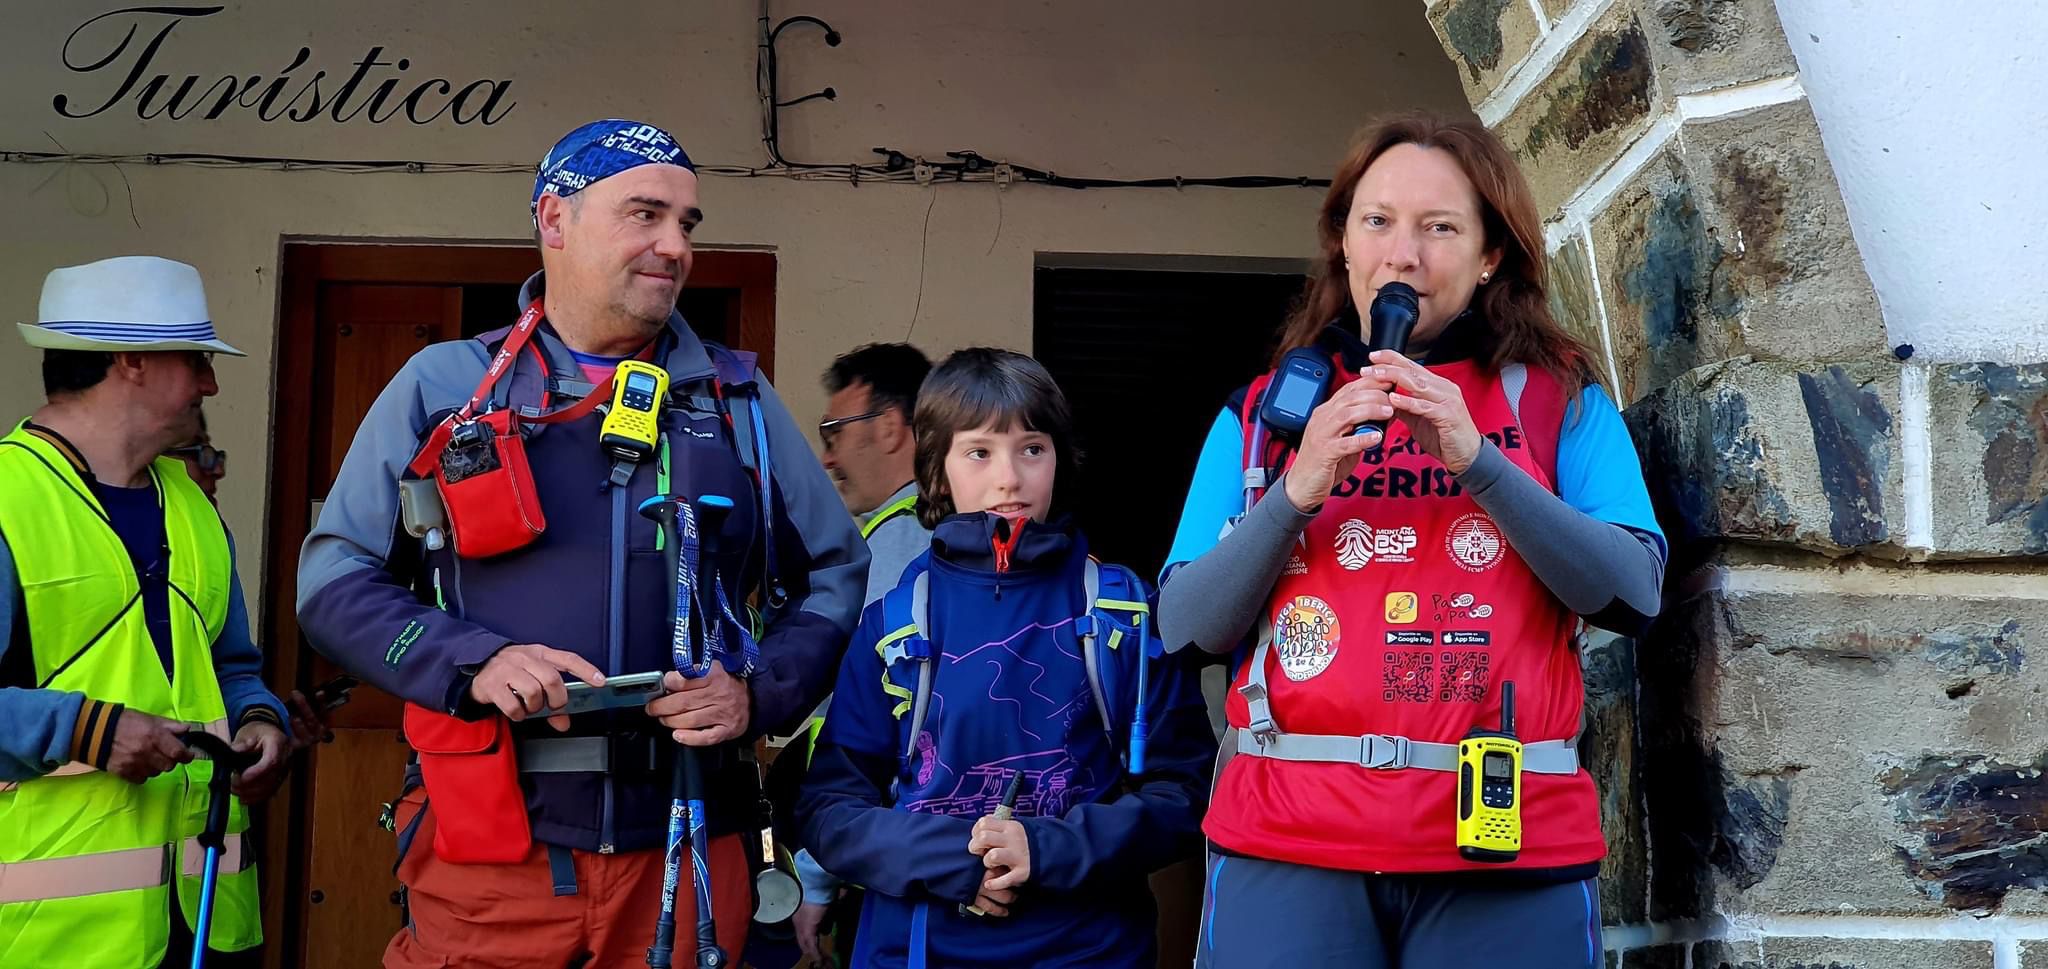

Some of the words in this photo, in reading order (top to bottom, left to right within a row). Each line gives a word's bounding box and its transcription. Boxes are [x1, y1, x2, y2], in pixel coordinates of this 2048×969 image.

[53, 5, 517, 126] Turística
[1277, 602, 1295, 626] LIGA
[1299, 597, 1336, 626] IBERICA
[674, 616, 688, 658] crivit
[1280, 639, 1329, 660] 2023
[1397, 636, 1419, 644] Google
[1420, 636, 1433, 644] Play
[1454, 636, 1468, 644] App
